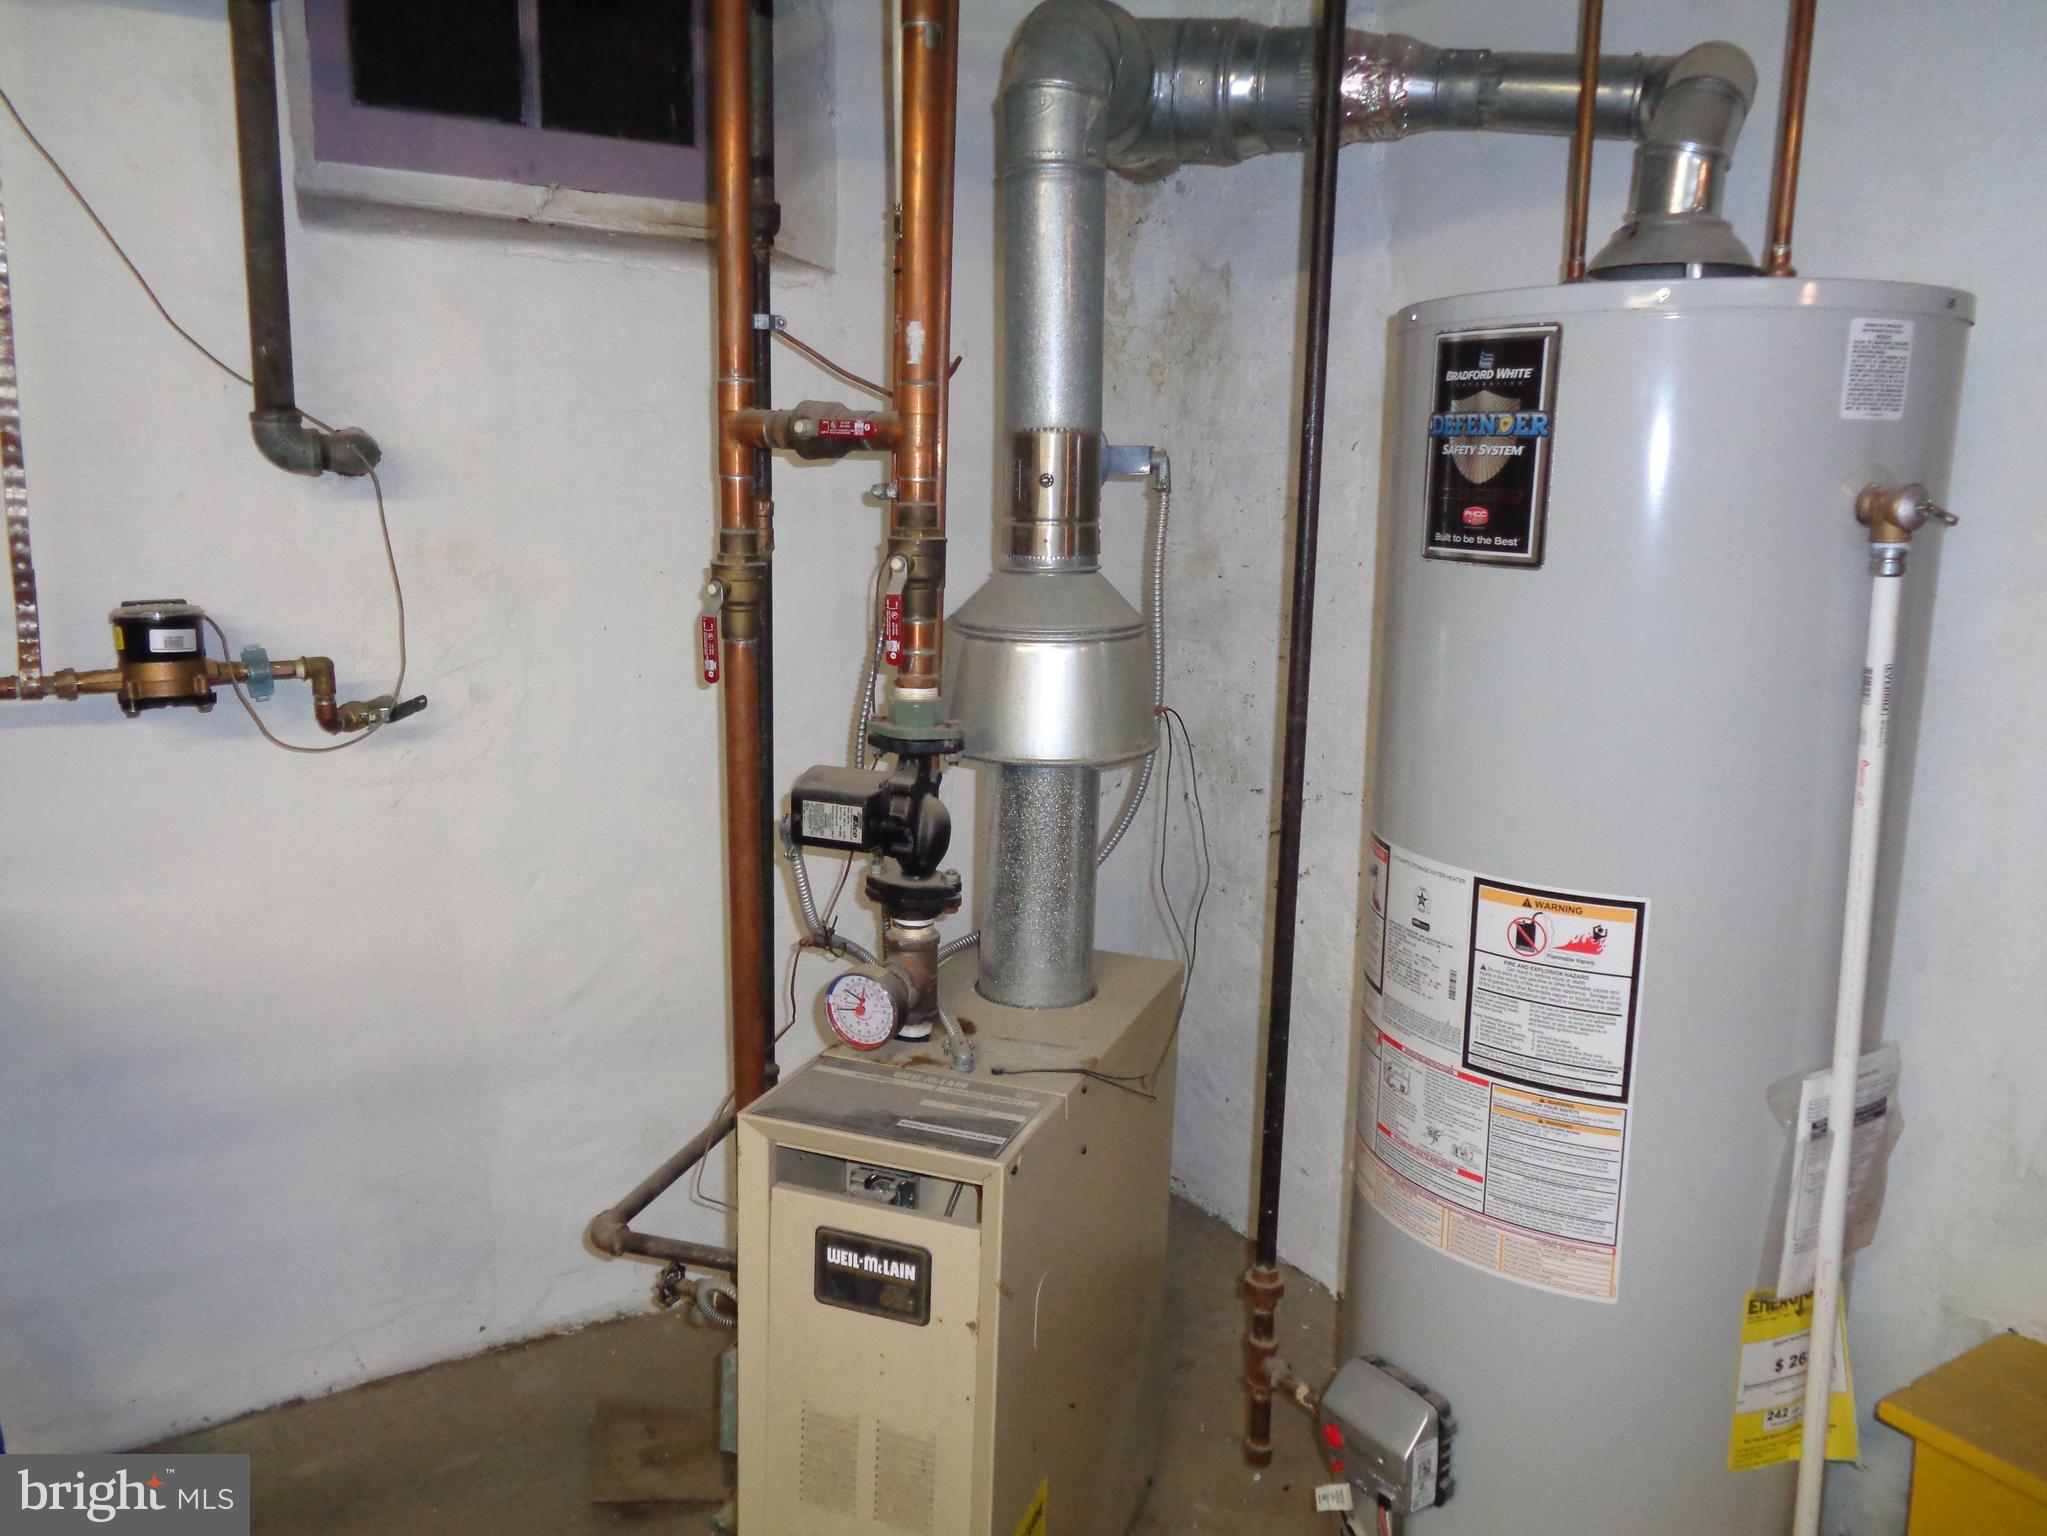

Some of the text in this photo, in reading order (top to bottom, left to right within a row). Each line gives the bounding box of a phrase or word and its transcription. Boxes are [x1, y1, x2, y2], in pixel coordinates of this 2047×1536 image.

[1446, 368, 1534, 382] BRADFORD WHITE
[1430, 411, 1549, 437] DEFENDER
[1442, 444, 1477, 456] SAFETY
[1435, 533, 1451, 542] Built
[1453, 535, 1461, 543] to
[1463, 535, 1475, 544] be
[1477, 536, 1492, 545] the
[1534, 900, 1583, 915] WARNING
[1517, 962, 1529, 970] AND
